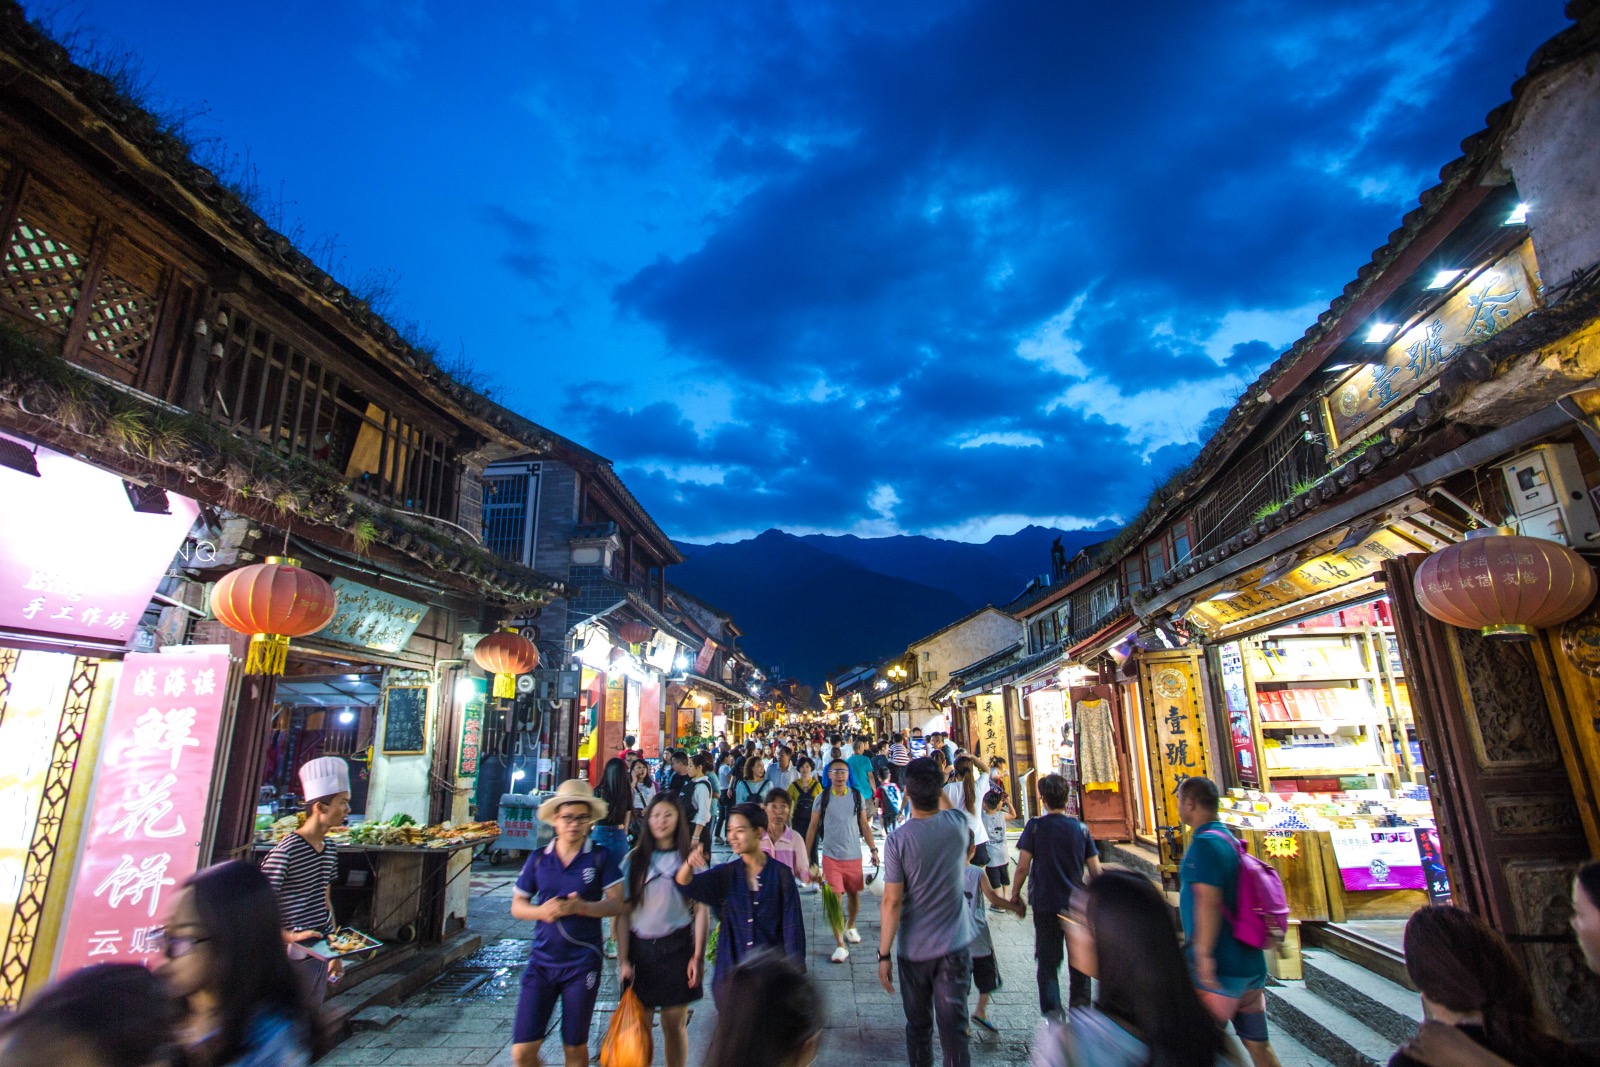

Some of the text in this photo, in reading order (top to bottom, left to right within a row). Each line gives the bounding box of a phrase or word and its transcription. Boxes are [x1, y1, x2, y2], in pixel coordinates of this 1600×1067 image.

[22, 595, 131, 630] 手工作坊
[505, 806, 534, 822] 清真
